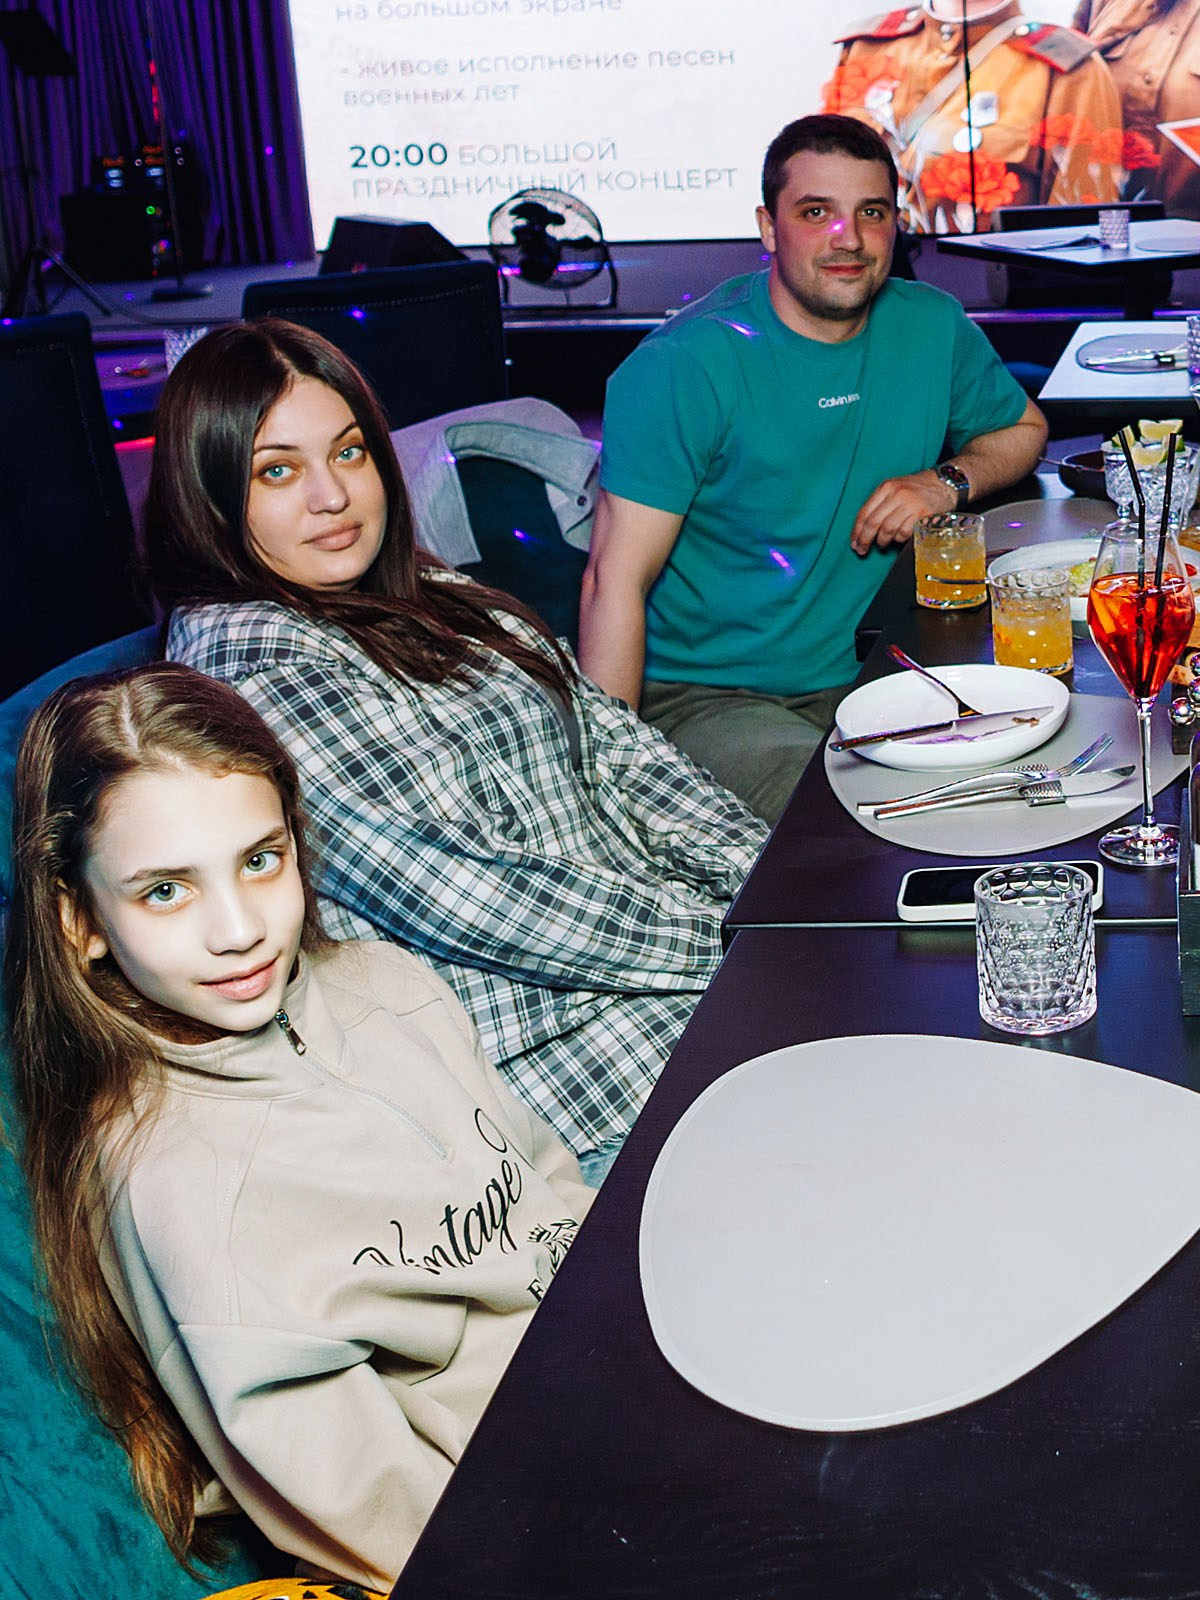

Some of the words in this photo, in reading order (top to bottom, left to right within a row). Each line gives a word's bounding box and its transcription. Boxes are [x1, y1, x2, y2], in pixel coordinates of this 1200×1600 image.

[335, 5, 369, 21] на
[376, 0, 509, 20] большом
[519, 0, 622, 17] экране
[358, 59, 450, 78] живое
[458, 51, 638, 74] исполнение
[648, 49, 735, 68] песен
[343, 87, 465, 106] военных
[474, 83, 521, 102] лет
[349, 142, 449, 168] 20:00
[458, 137, 618, 166] БОЛЬШОЙ
[351, 168, 587, 199] ПРАЗДНИЧНЫЙ
[596, 167, 739, 192] КОНЦЕРТ
[352, 1159, 523, 1276] Vntage
